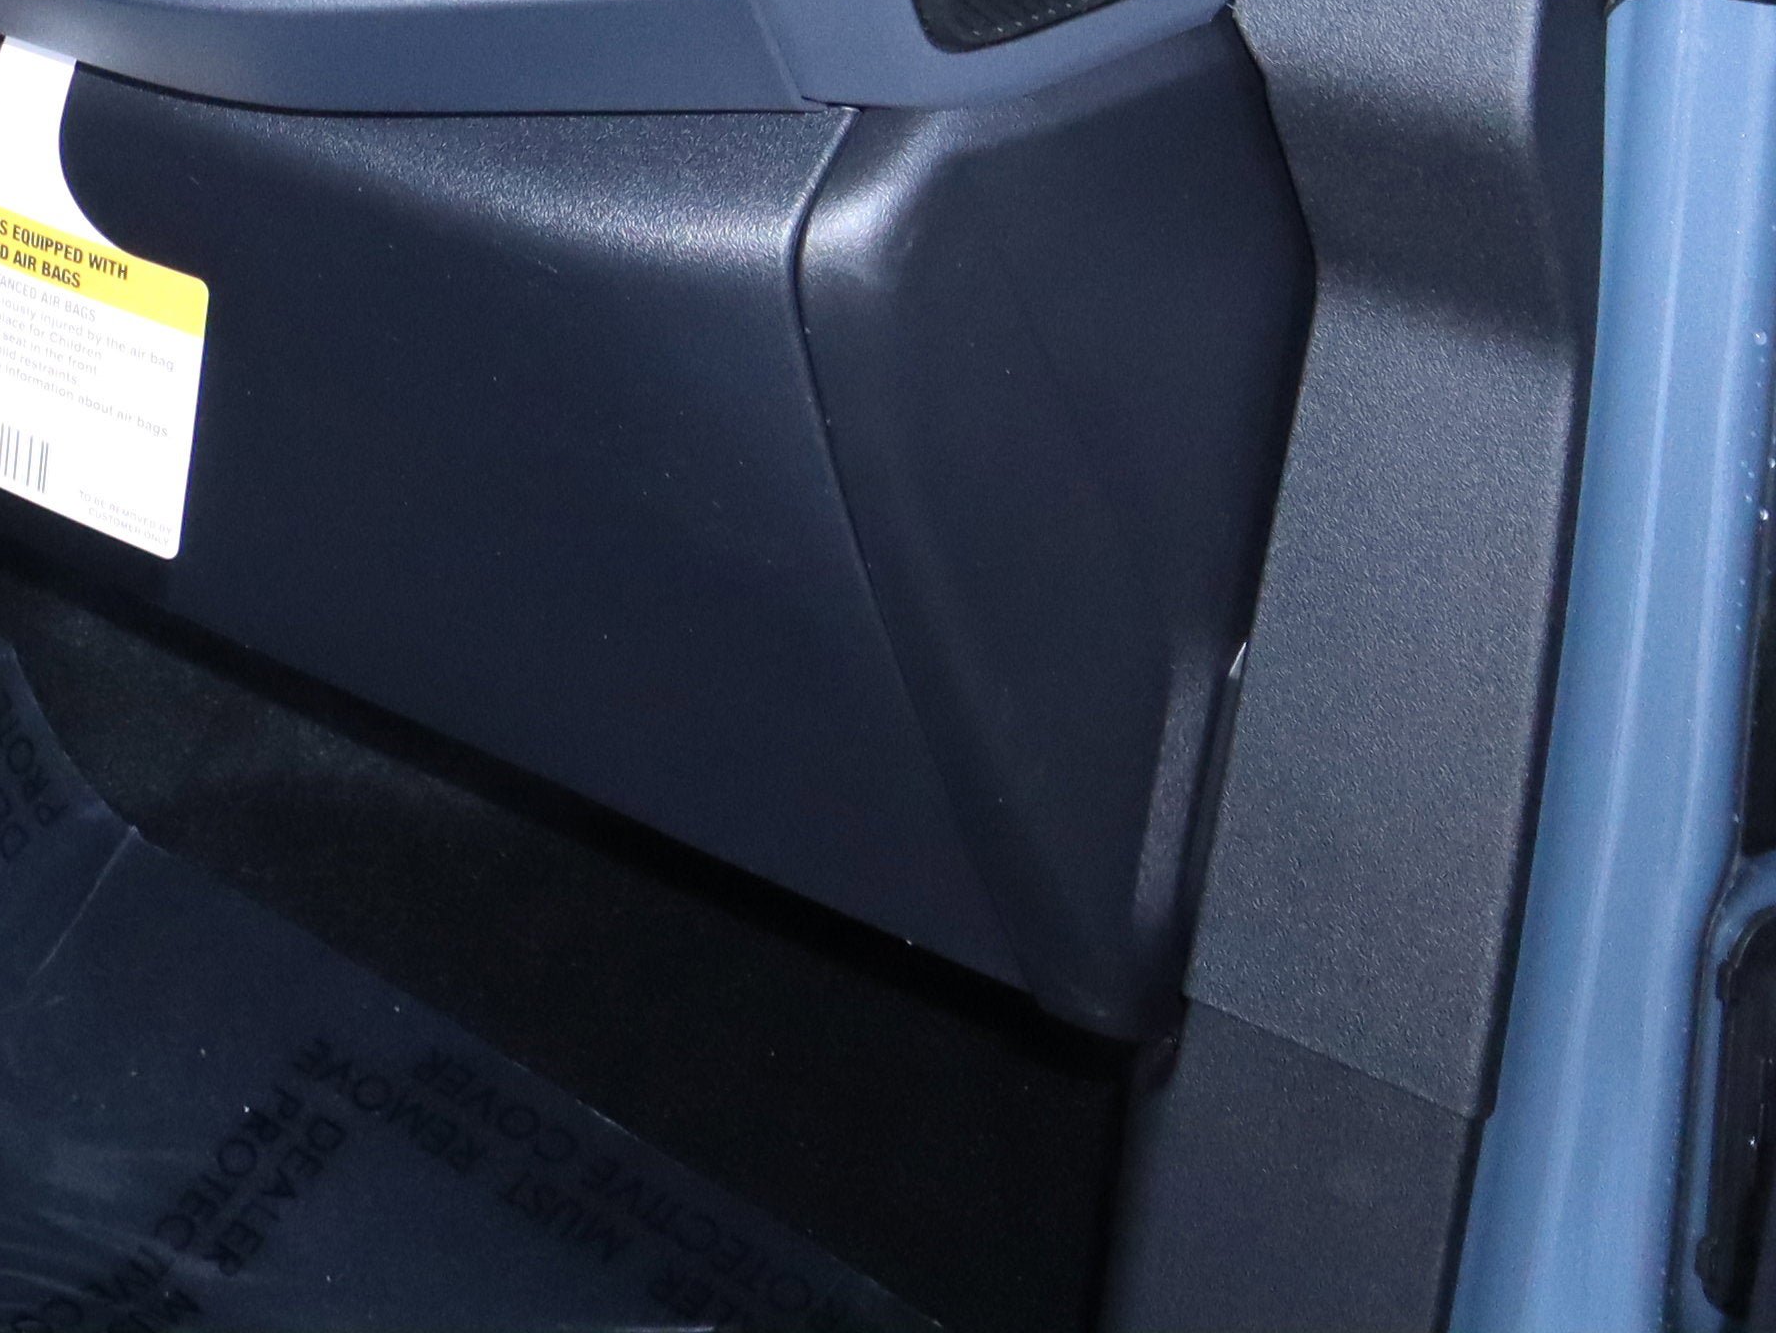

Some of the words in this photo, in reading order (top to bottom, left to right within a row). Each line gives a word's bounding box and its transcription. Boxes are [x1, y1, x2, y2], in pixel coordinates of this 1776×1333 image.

[12, 227, 84, 265] EQUIPPED
[88, 253, 129, 281] WITH
[12, 250, 37, 273] AIR
[41, 257, 81, 289] BAGS
[40, 291, 60, 309] AIR
[64, 300, 96, 323] BAGS
[2, 332, 27, 349] seat
[30, 342, 42, 354] in
[45, 347, 64, 363] the
[68, 355, 98, 376] front
[29, 323, 46, 338] for
[49, 331, 103, 361] Children
[40, 313, 84, 337] injured
[87, 327, 102, 346] by
[106, 337, 127, 353] the
[131, 347, 147, 360] air
[150, 352, 175, 373] bag
[5, 363, 75, 402] information
[78, 394, 114, 418] about
[118, 411, 134, 423] air
[136, 415, 169, 439] bags
